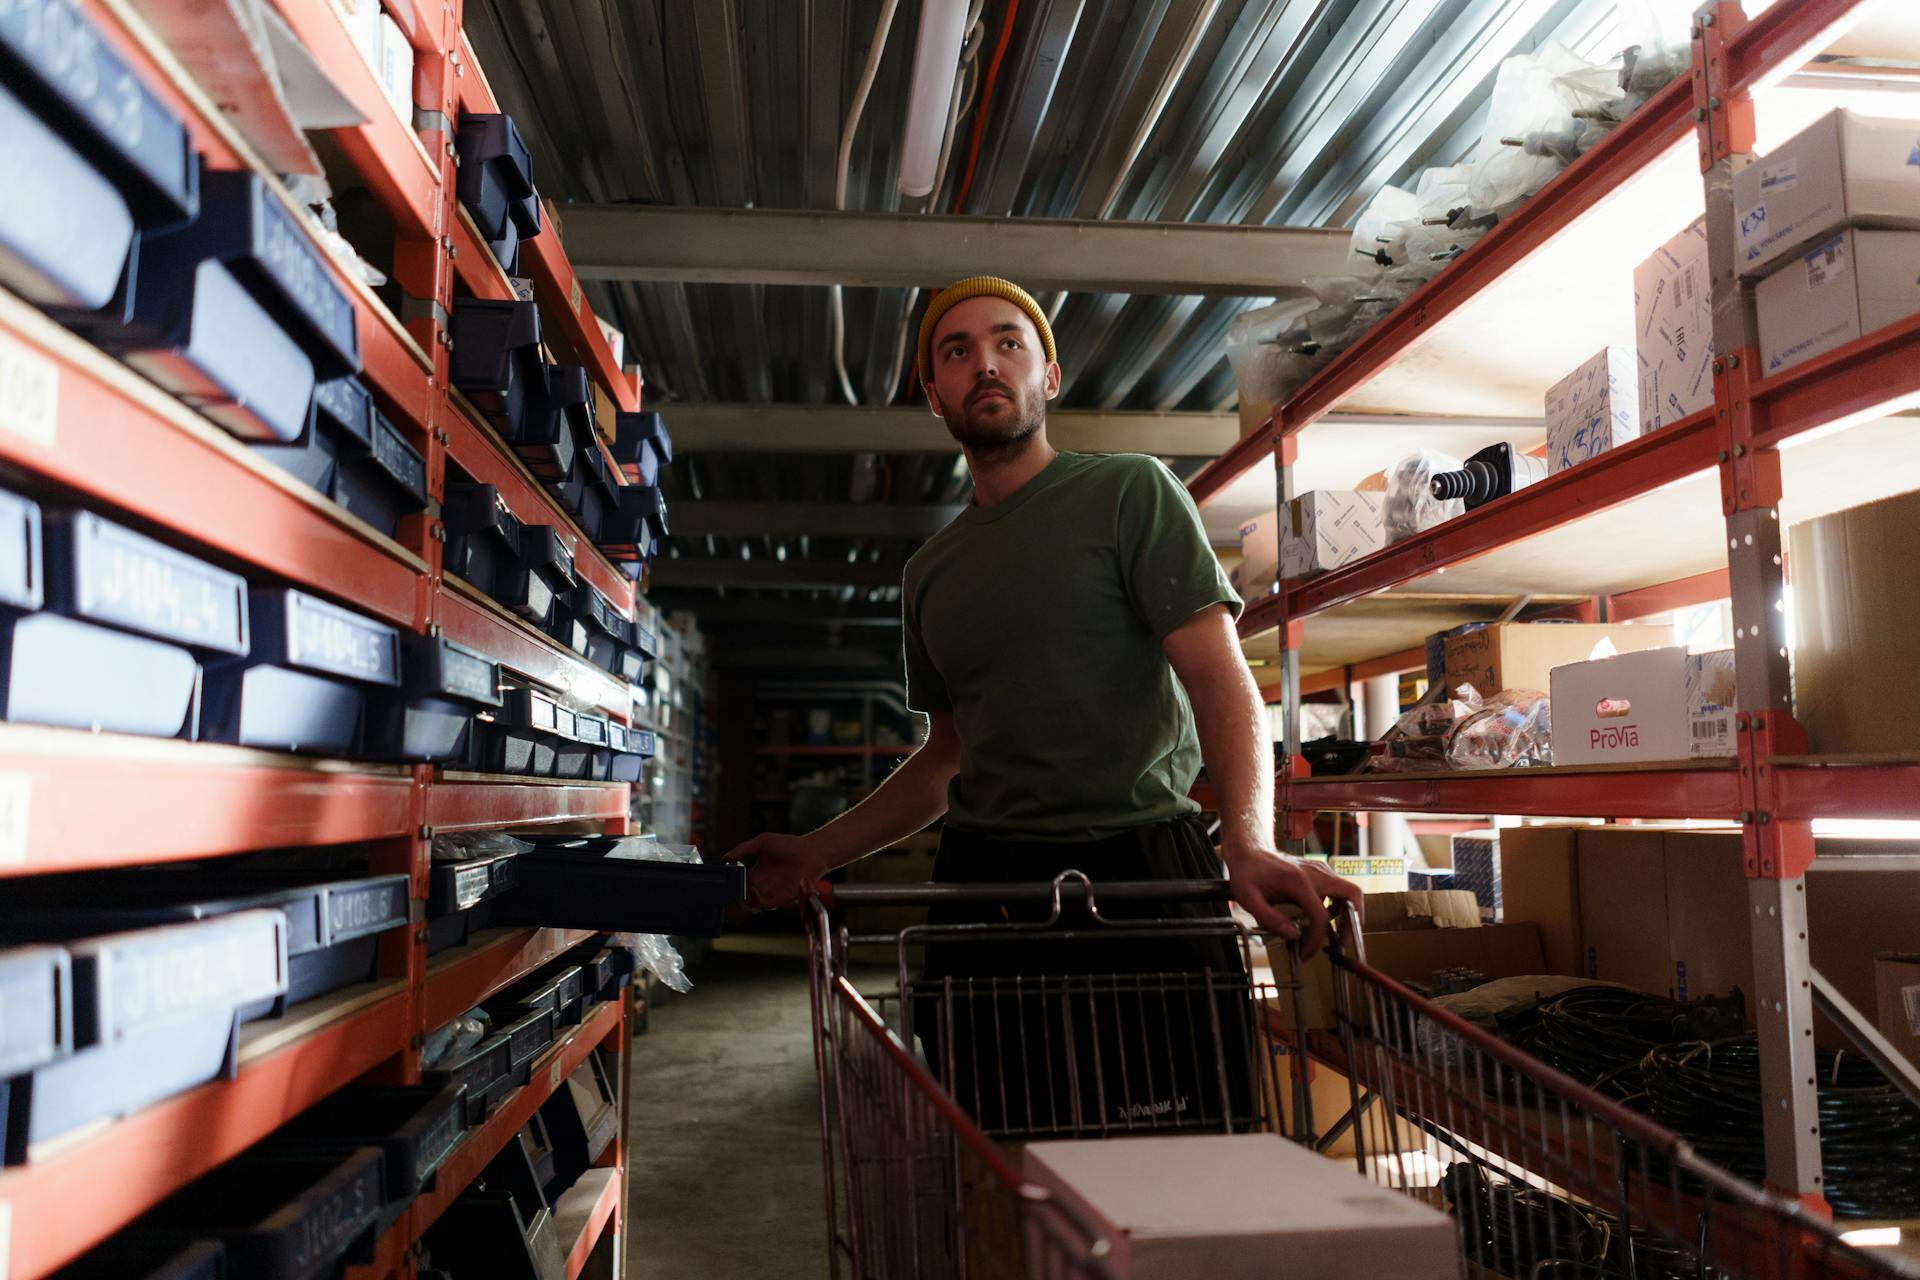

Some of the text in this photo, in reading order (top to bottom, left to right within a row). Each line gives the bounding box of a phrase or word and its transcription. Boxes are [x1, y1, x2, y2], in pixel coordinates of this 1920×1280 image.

[303, 611, 381, 672] J104_5
[1590, 725, 1639, 749] ProVia
[1335, 859, 1403, 868] MANN MANN
[333, 888, 389, 931] J103_6
